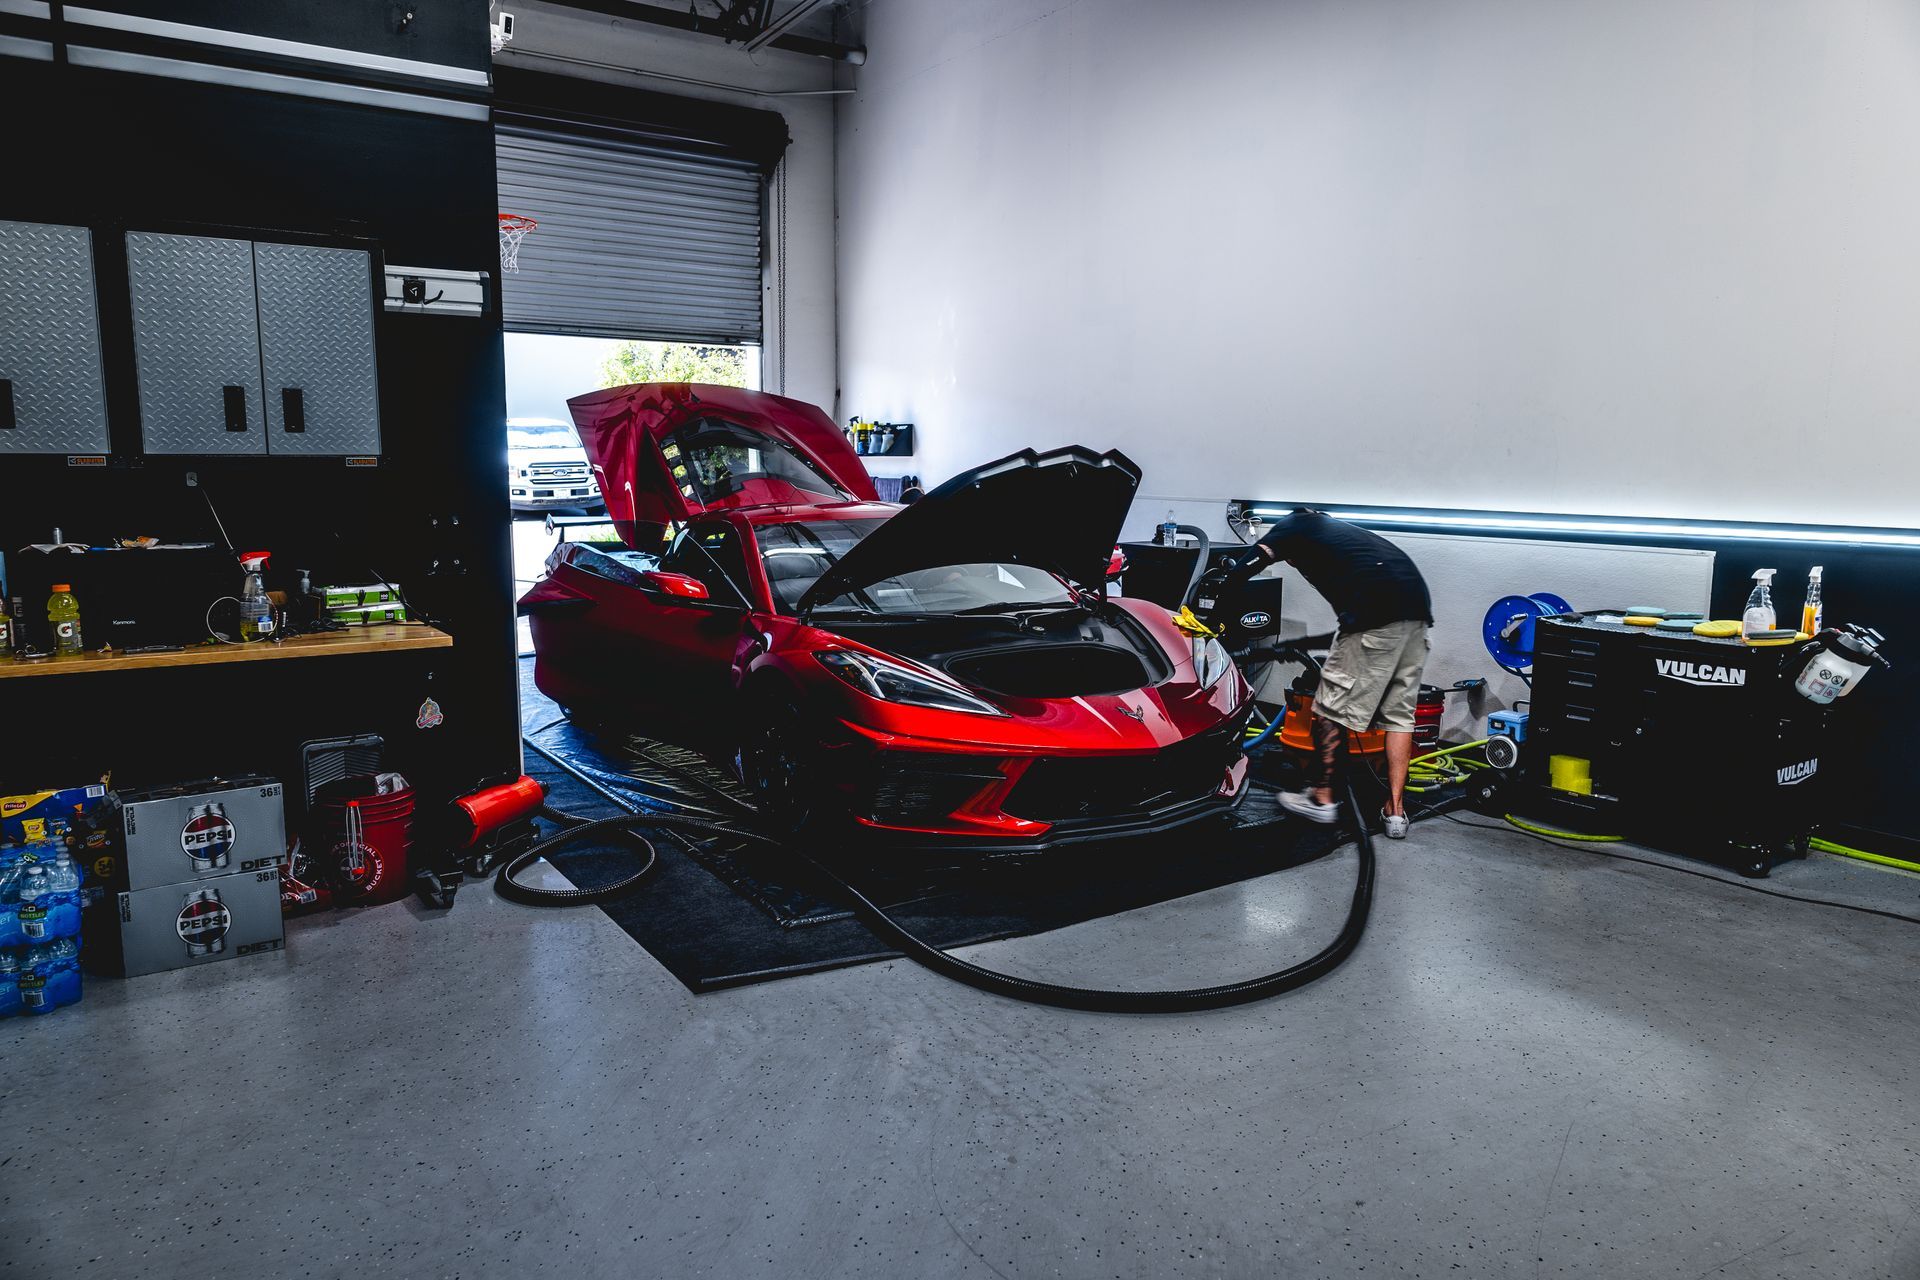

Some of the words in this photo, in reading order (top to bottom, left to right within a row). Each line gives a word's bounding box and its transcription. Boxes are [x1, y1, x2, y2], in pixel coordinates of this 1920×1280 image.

[57, 622, 73, 638] G
[1655, 658, 1746, 685] VULCAN
[1776, 757, 1818, 784] VULCAN
[260, 787, 273, 798] 36
[184, 829, 233, 846] PEPSI
[240, 854, 286, 871] DIET
[256, 872, 270, 883] 36
[365, 858, 383, 891] BUCKET
[179, 914, 228, 931] PEPSI
[236, 938, 282, 956] DIET
